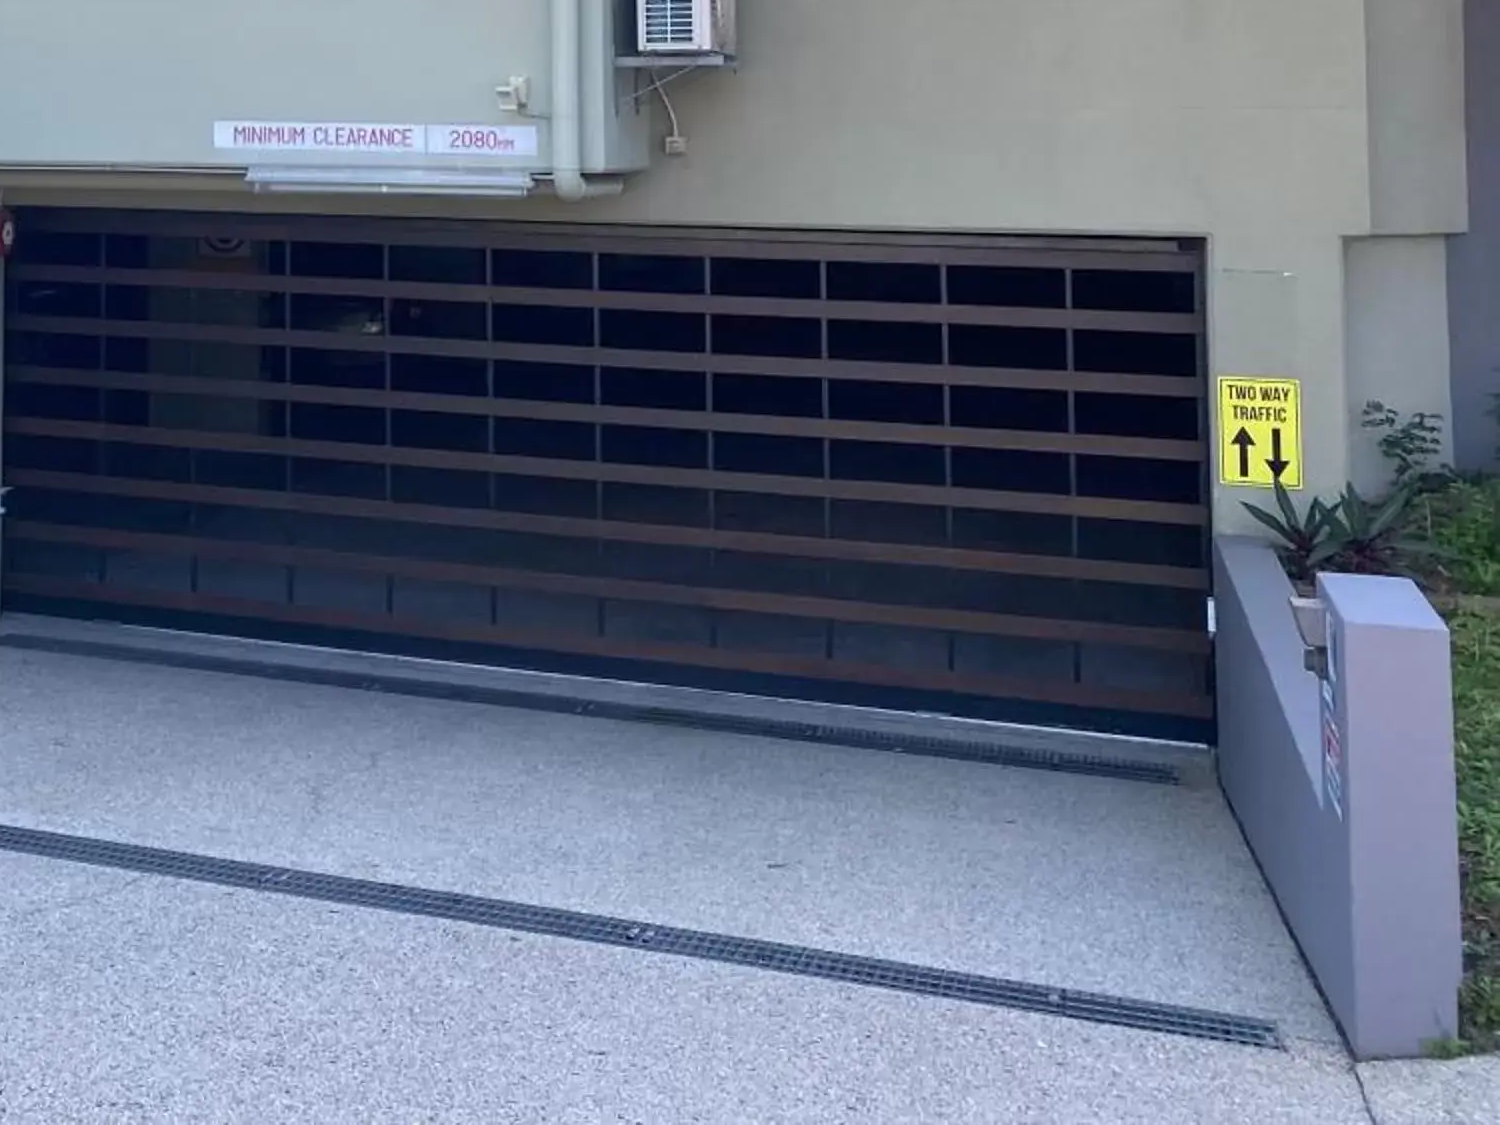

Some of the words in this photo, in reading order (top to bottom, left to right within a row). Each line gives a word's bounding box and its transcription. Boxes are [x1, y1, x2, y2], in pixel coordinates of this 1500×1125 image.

[233, 124, 305, 146] MINIMUM
[313, 126, 413, 147] CLEARANCE
[1227, 385, 1257, 401] TWO
[1260, 387, 1291, 402] WAY
[1232, 405, 1288, 423] TRAFFIC
